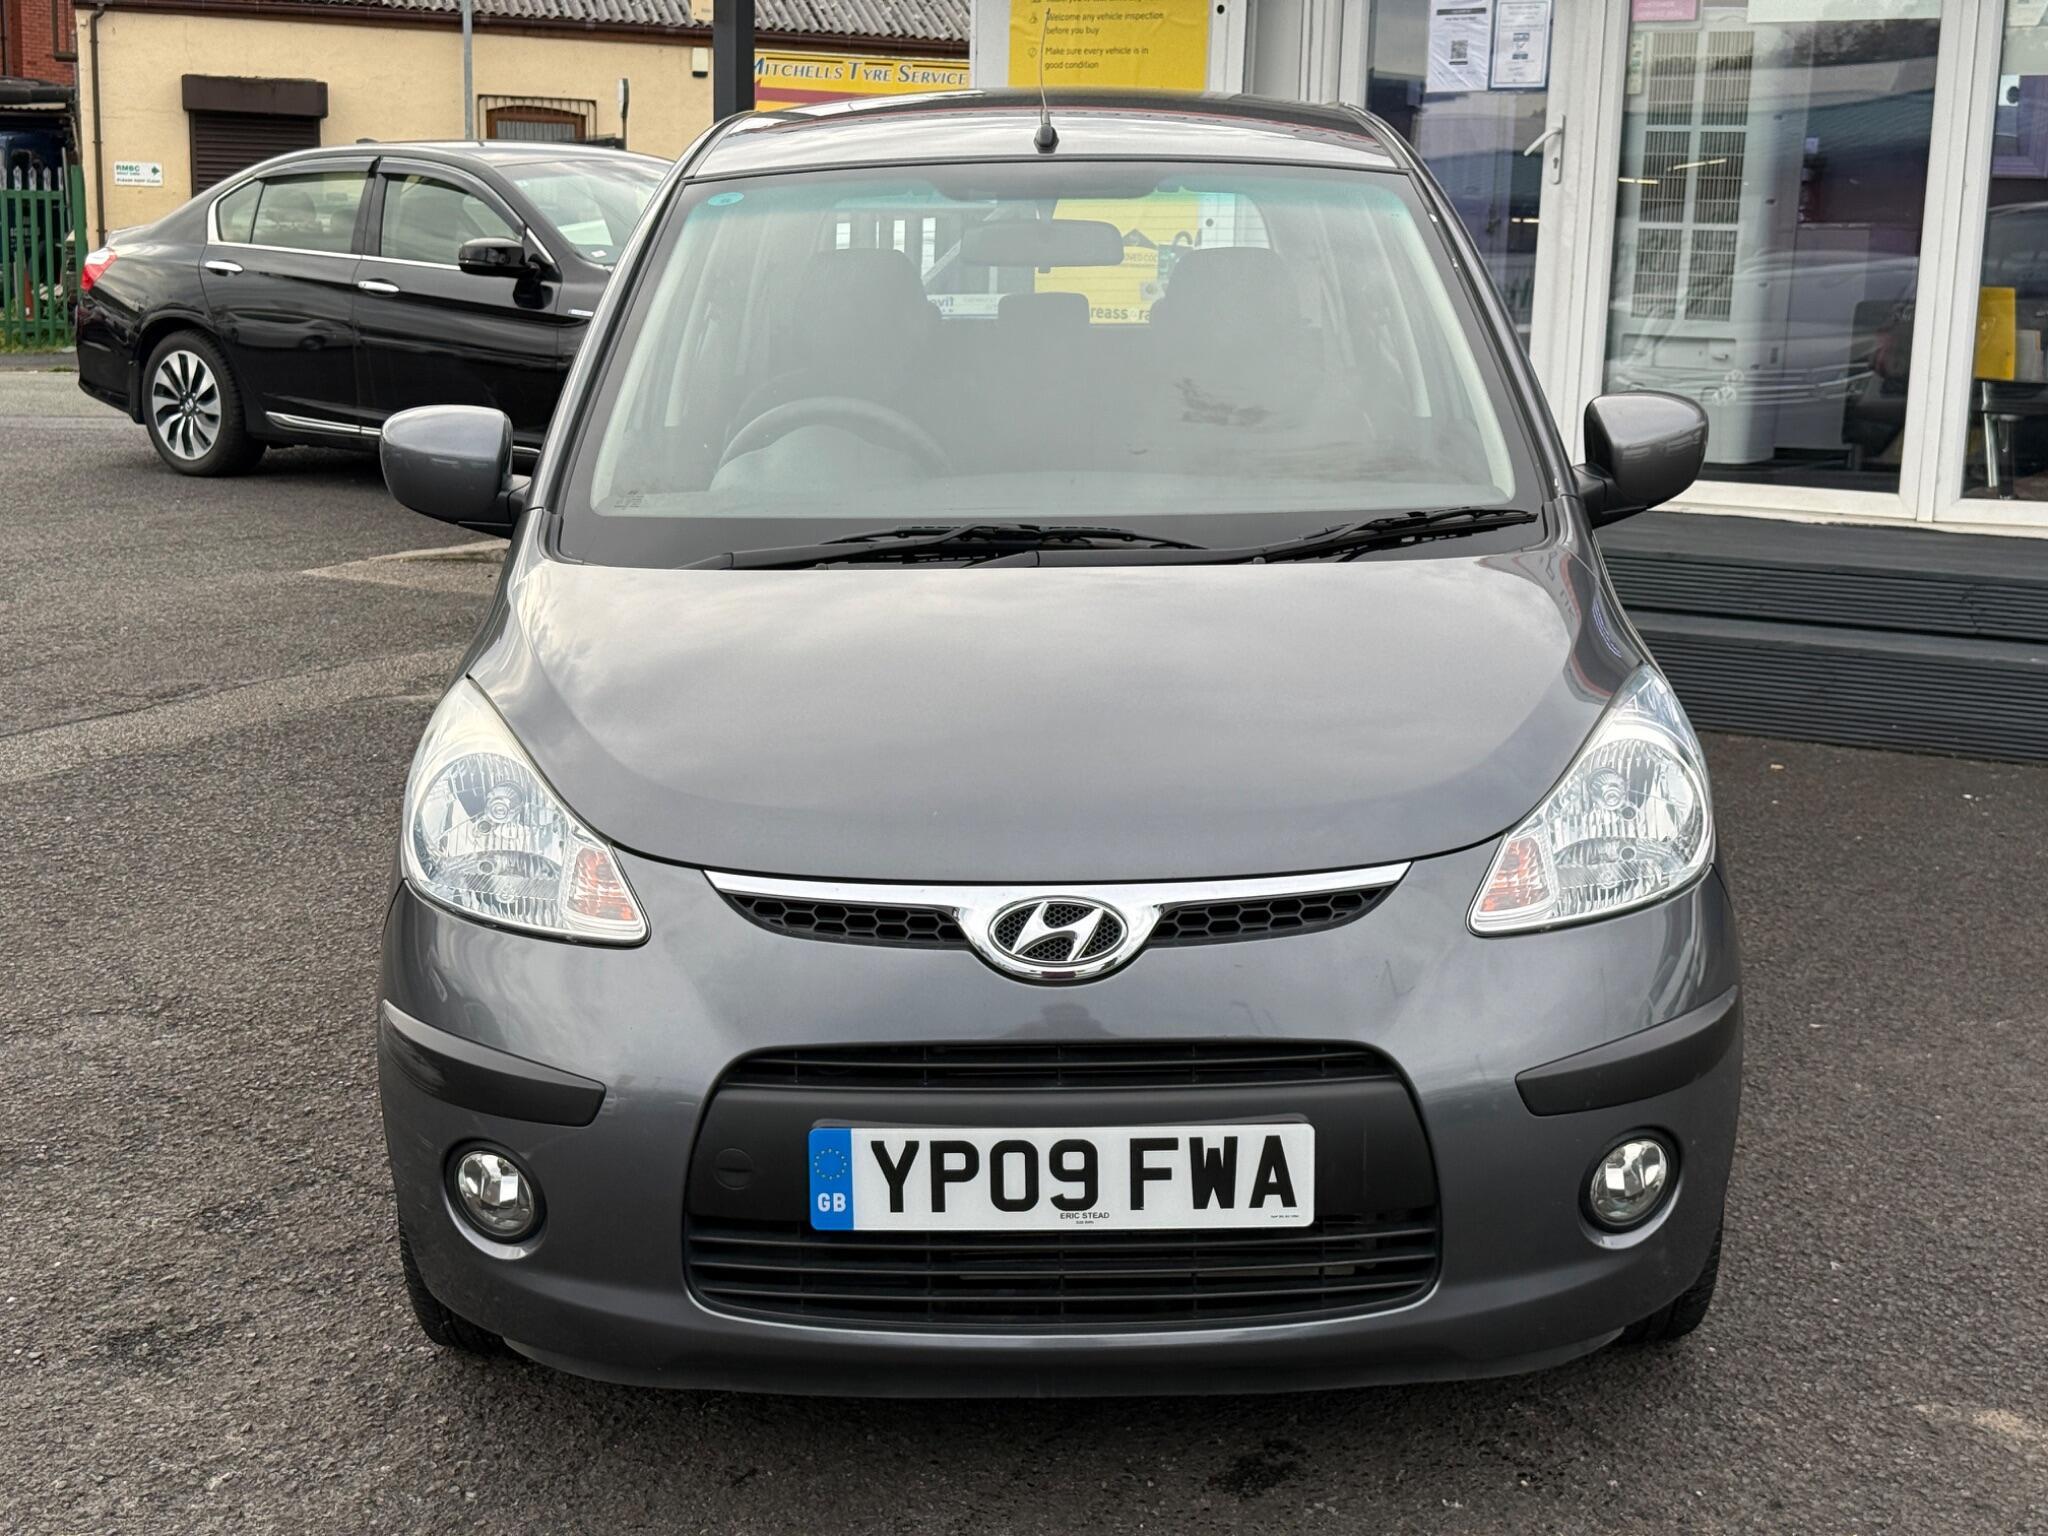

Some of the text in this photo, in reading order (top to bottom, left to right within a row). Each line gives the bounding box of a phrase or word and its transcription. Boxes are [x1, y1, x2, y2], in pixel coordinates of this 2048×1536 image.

[1082, 14, 1095, 23] any
[1096, 12, 1122, 21] vehicle
[1124, 11, 1164, 22] inspection
[1046, 26, 1069, 34] before
[1085, 26, 1099, 36] buy
[1045, 47, 1065, 55] Make
[1083, 48, 1103, 57] every
[1105, 46, 1131, 55] vehicle
[1044, 60, 1099, 70] good condition
[848, 61, 892, 82] TYRE
[898, 64, 966, 85] SERVICE
[870, 1135, 1297, 1213] YP09 FWA
[817, 1192, 847, 1212] GB
[1060, 1211, 1110, 1220] ERIC STEAD
